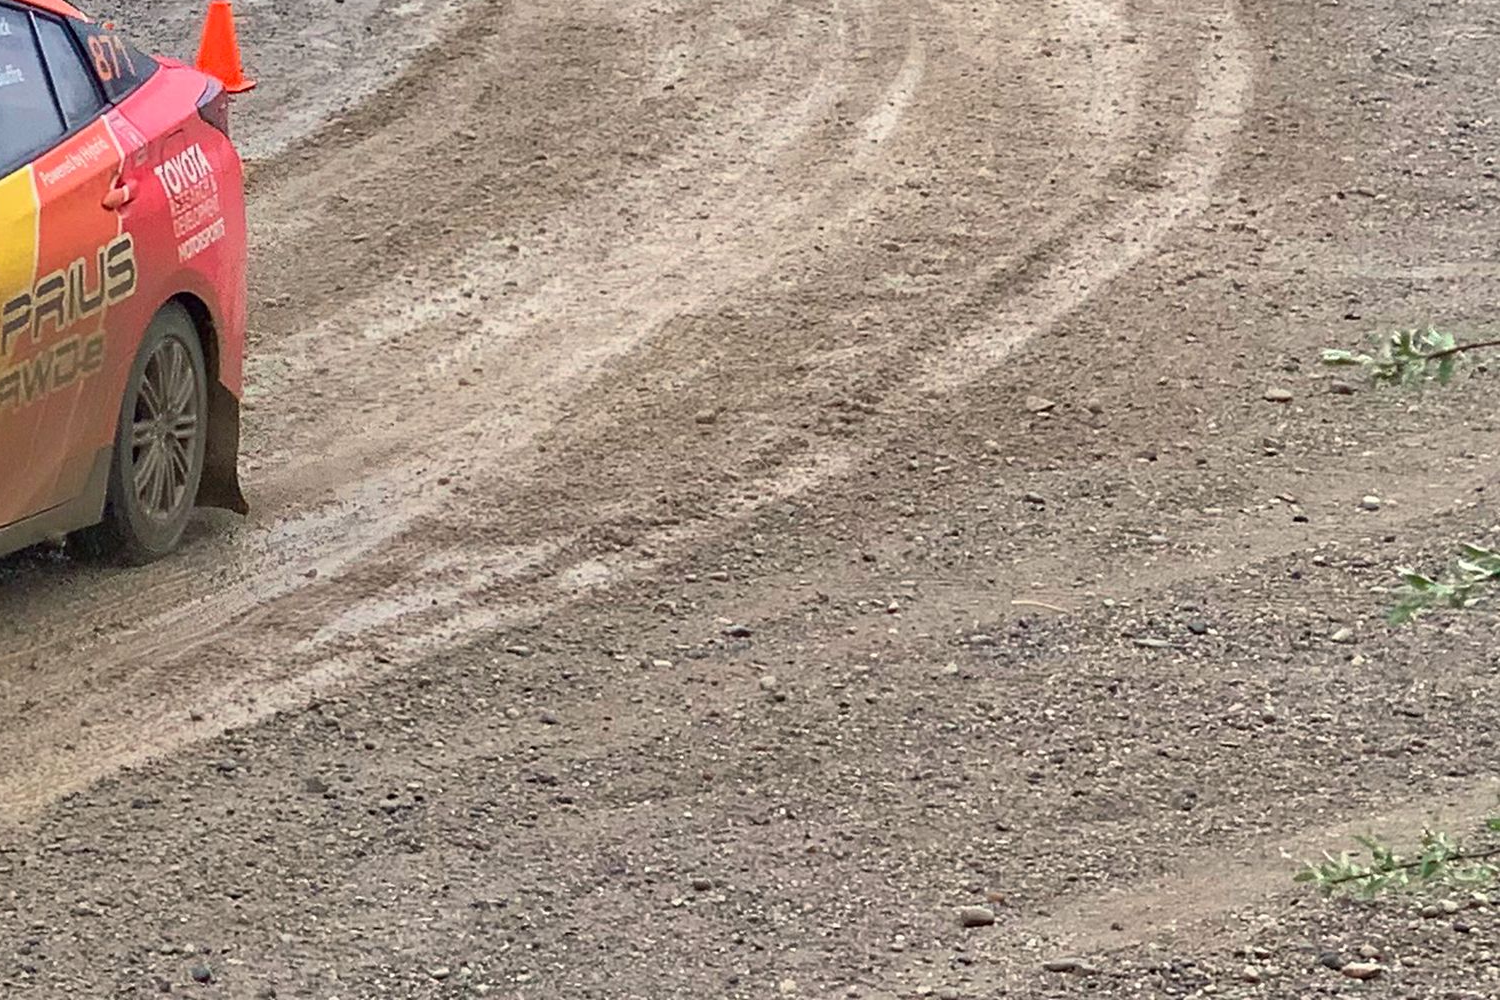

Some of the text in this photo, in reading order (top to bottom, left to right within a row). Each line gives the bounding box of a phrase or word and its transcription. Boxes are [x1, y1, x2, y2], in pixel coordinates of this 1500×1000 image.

[88, 34, 137, 81] 871
[153, 143, 213, 199] TOYOTA
[0, 232, 137, 357] PRIUS
